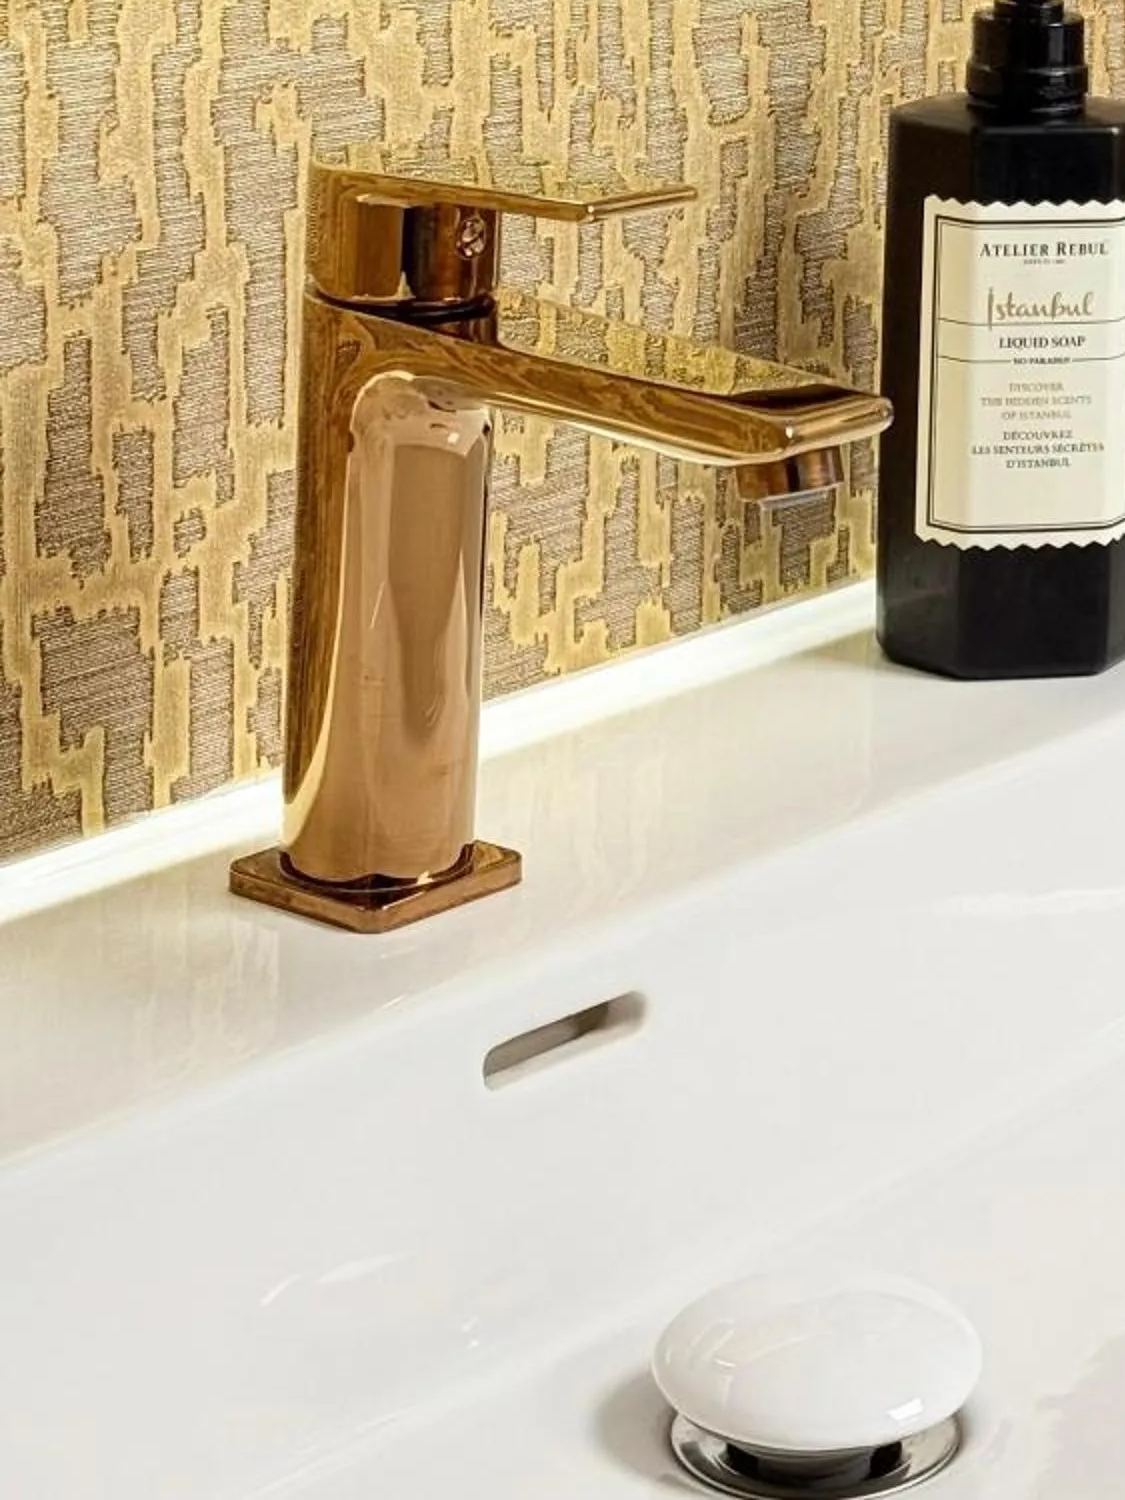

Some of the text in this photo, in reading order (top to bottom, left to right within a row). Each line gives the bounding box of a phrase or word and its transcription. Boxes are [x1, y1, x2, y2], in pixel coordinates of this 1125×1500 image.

[999, 335, 1087, 349] LIQUID SOAP
[1009, 382, 1064, 392] DISCOVER
